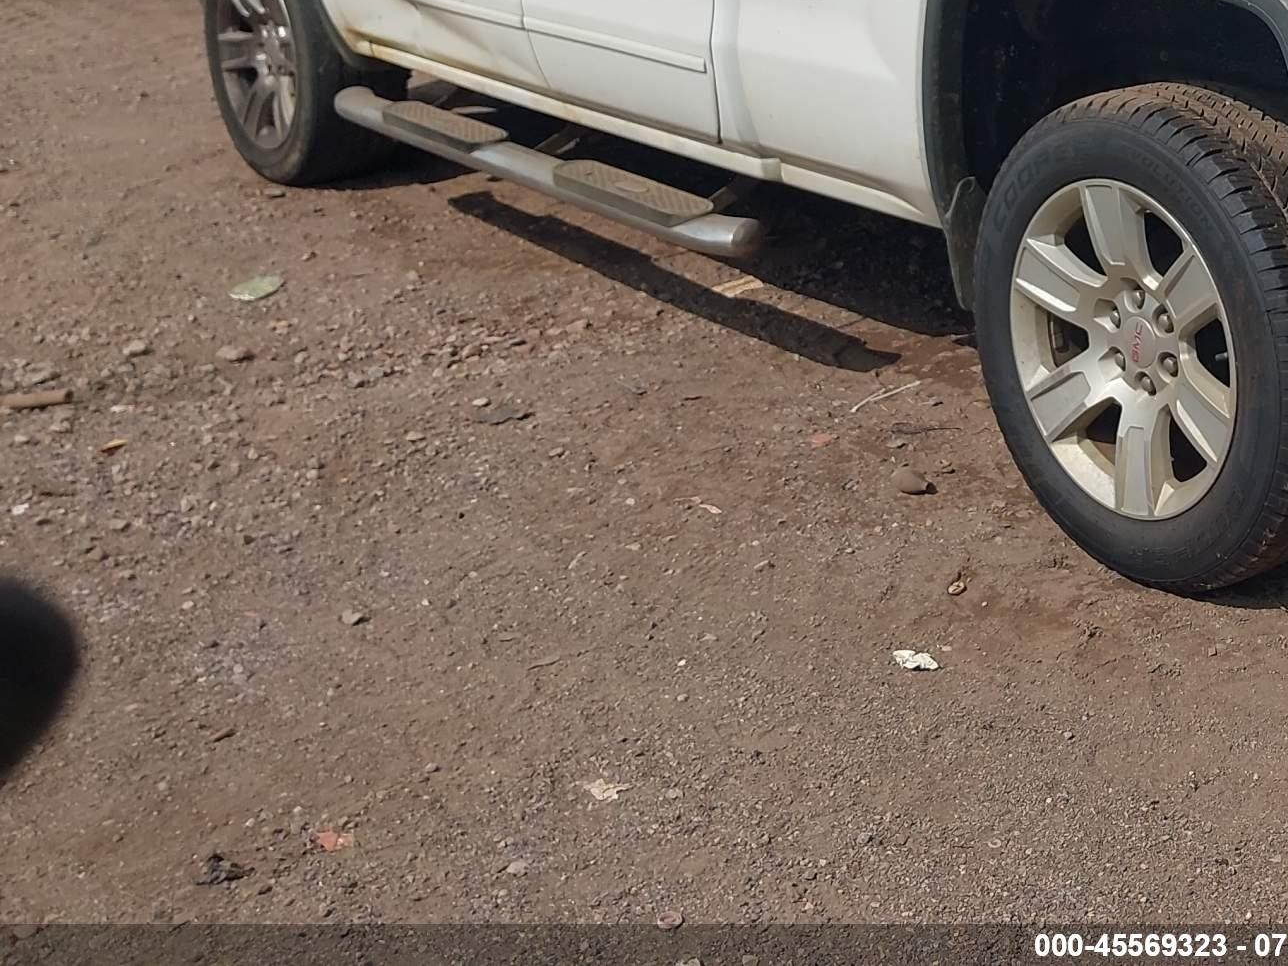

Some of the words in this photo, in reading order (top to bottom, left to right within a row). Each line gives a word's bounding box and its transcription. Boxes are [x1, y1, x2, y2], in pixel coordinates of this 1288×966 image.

[991, 135, 1086, 235] COOP
[1124, 148, 1213, 233] VOLUTION
[1130, 322, 1144, 363] GMC
